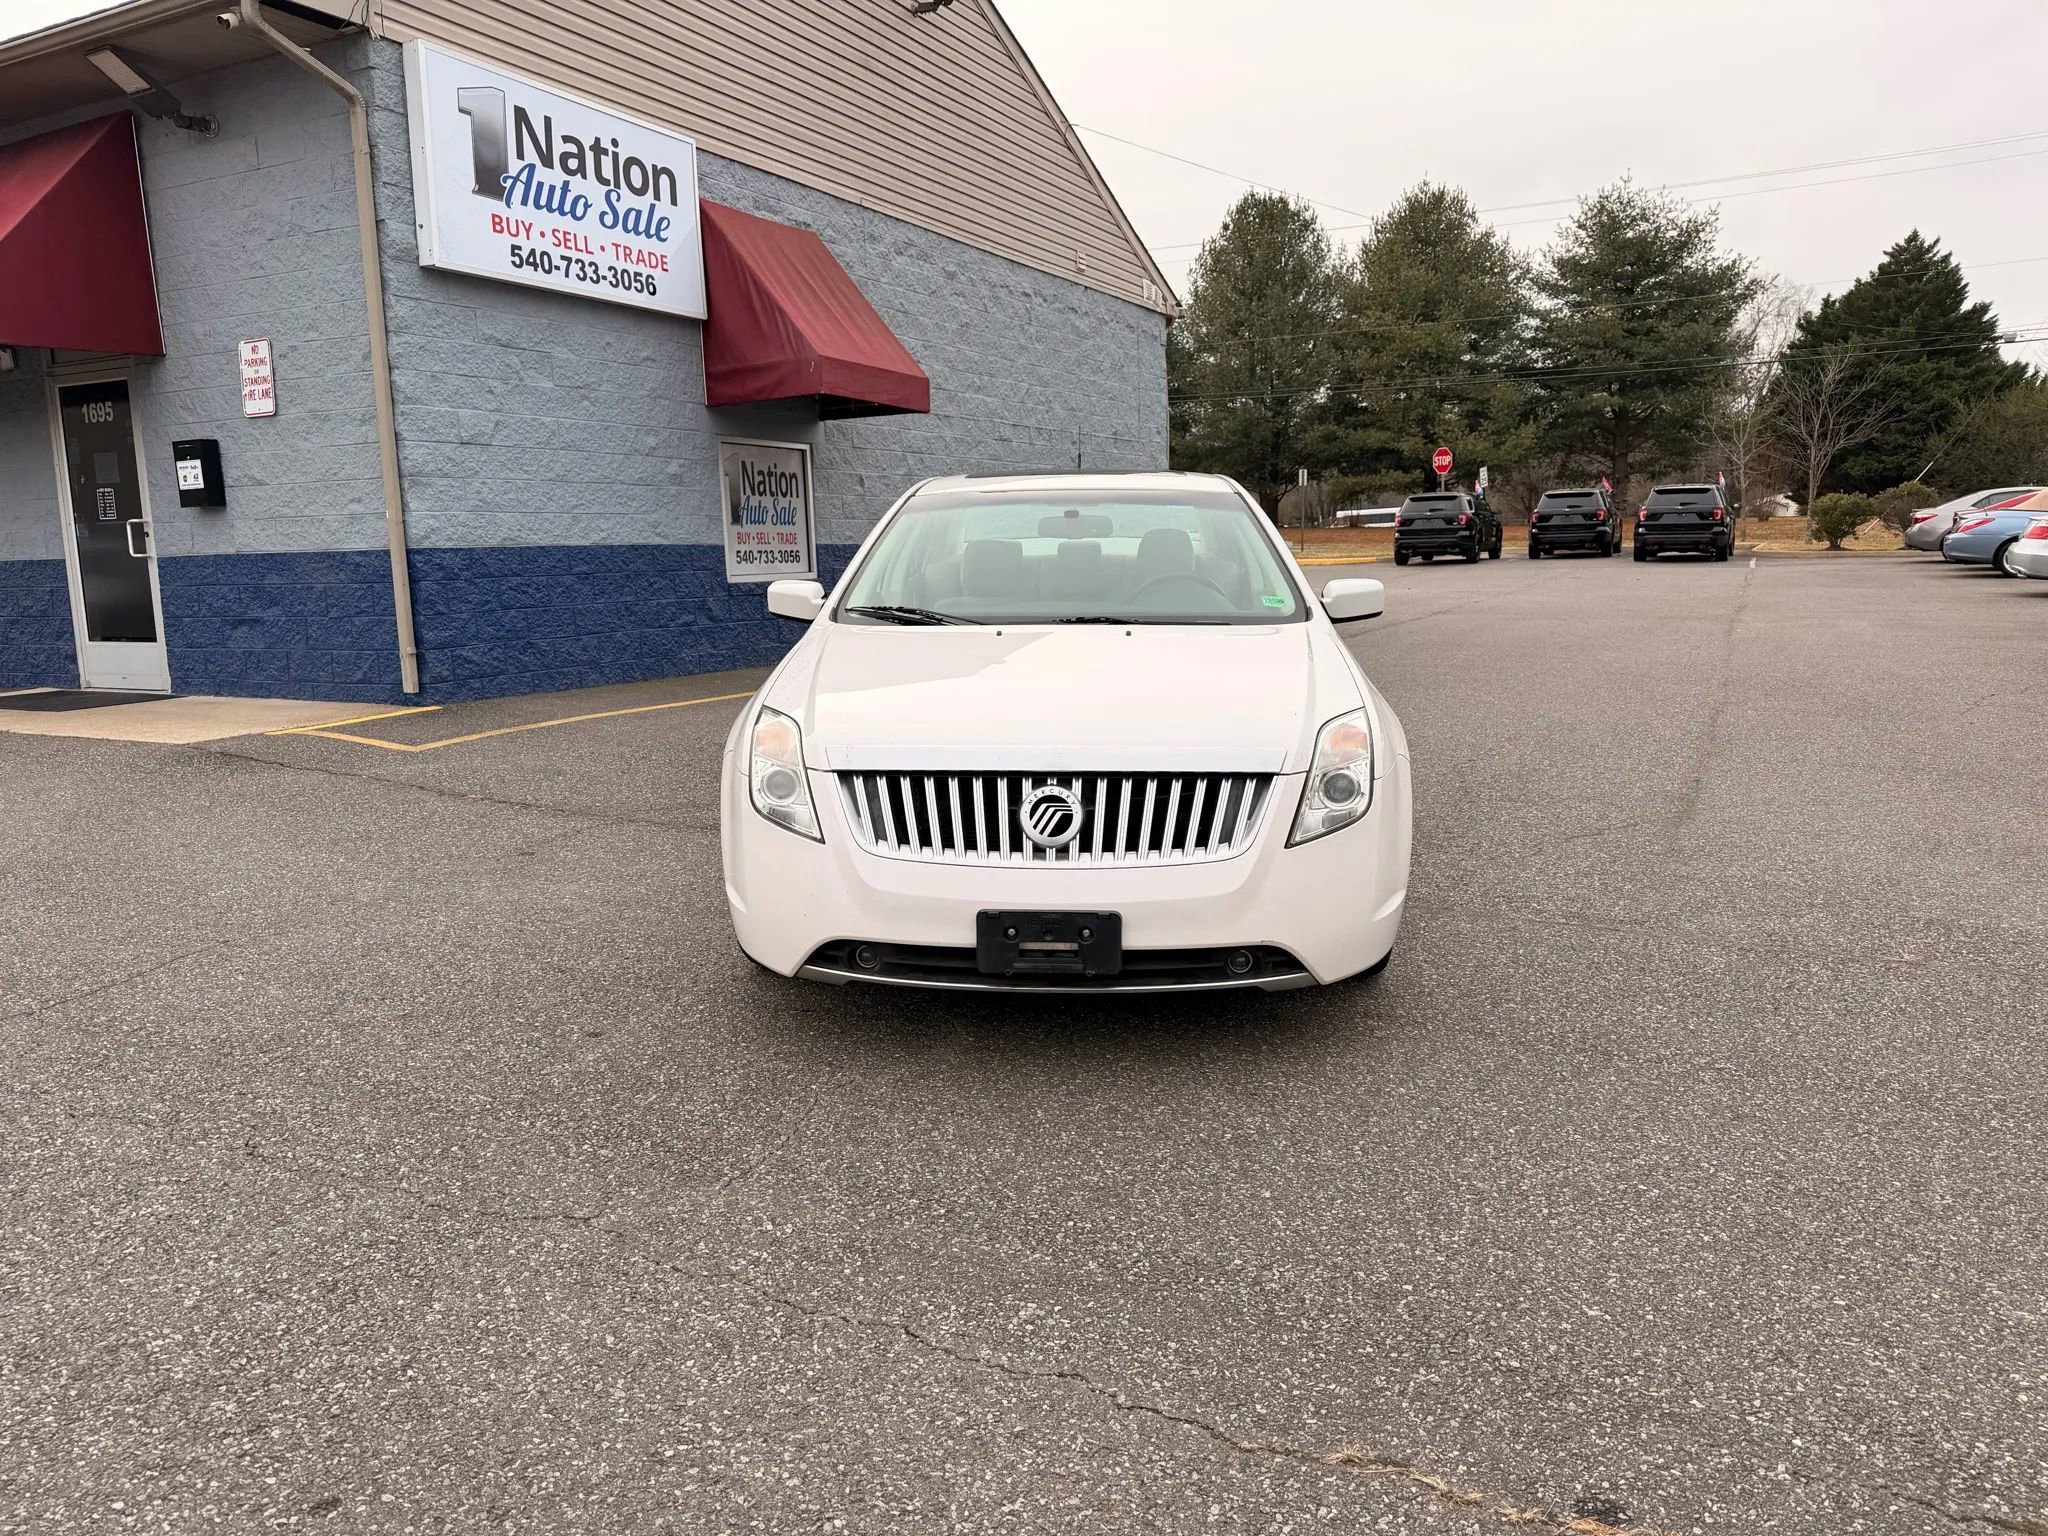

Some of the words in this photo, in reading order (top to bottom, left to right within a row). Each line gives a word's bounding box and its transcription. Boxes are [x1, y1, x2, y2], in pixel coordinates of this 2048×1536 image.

[513, 104, 678, 207] Nation
[502, 163, 593, 222] Auto
[599, 189, 671, 243] Sale
[491, 213, 533, 241] BUY
[552, 228, 594, 255] SELL
[611, 242, 669, 272] TRADE
[510, 244, 657, 296] 540-733-3056
[251, 344, 259, 355] NO
[244, 375, 270, 387] STANDING
[258, 388, 272, 400] LANE
[81, 401, 114, 424] 1695
[1434, 455, 1451, 466] STOP
[741, 460, 799, 498] Nation
[739, 495, 769, 528] Auto
[771, 498, 797, 526] Sale
[736, 532, 751, 544] BUY
[756, 532, 771, 545] SELL
[777, 532, 797, 545] TRADE
[736, 550, 800, 565] 540-733-3056
[1028, 788, 1077, 805] MERCURY
